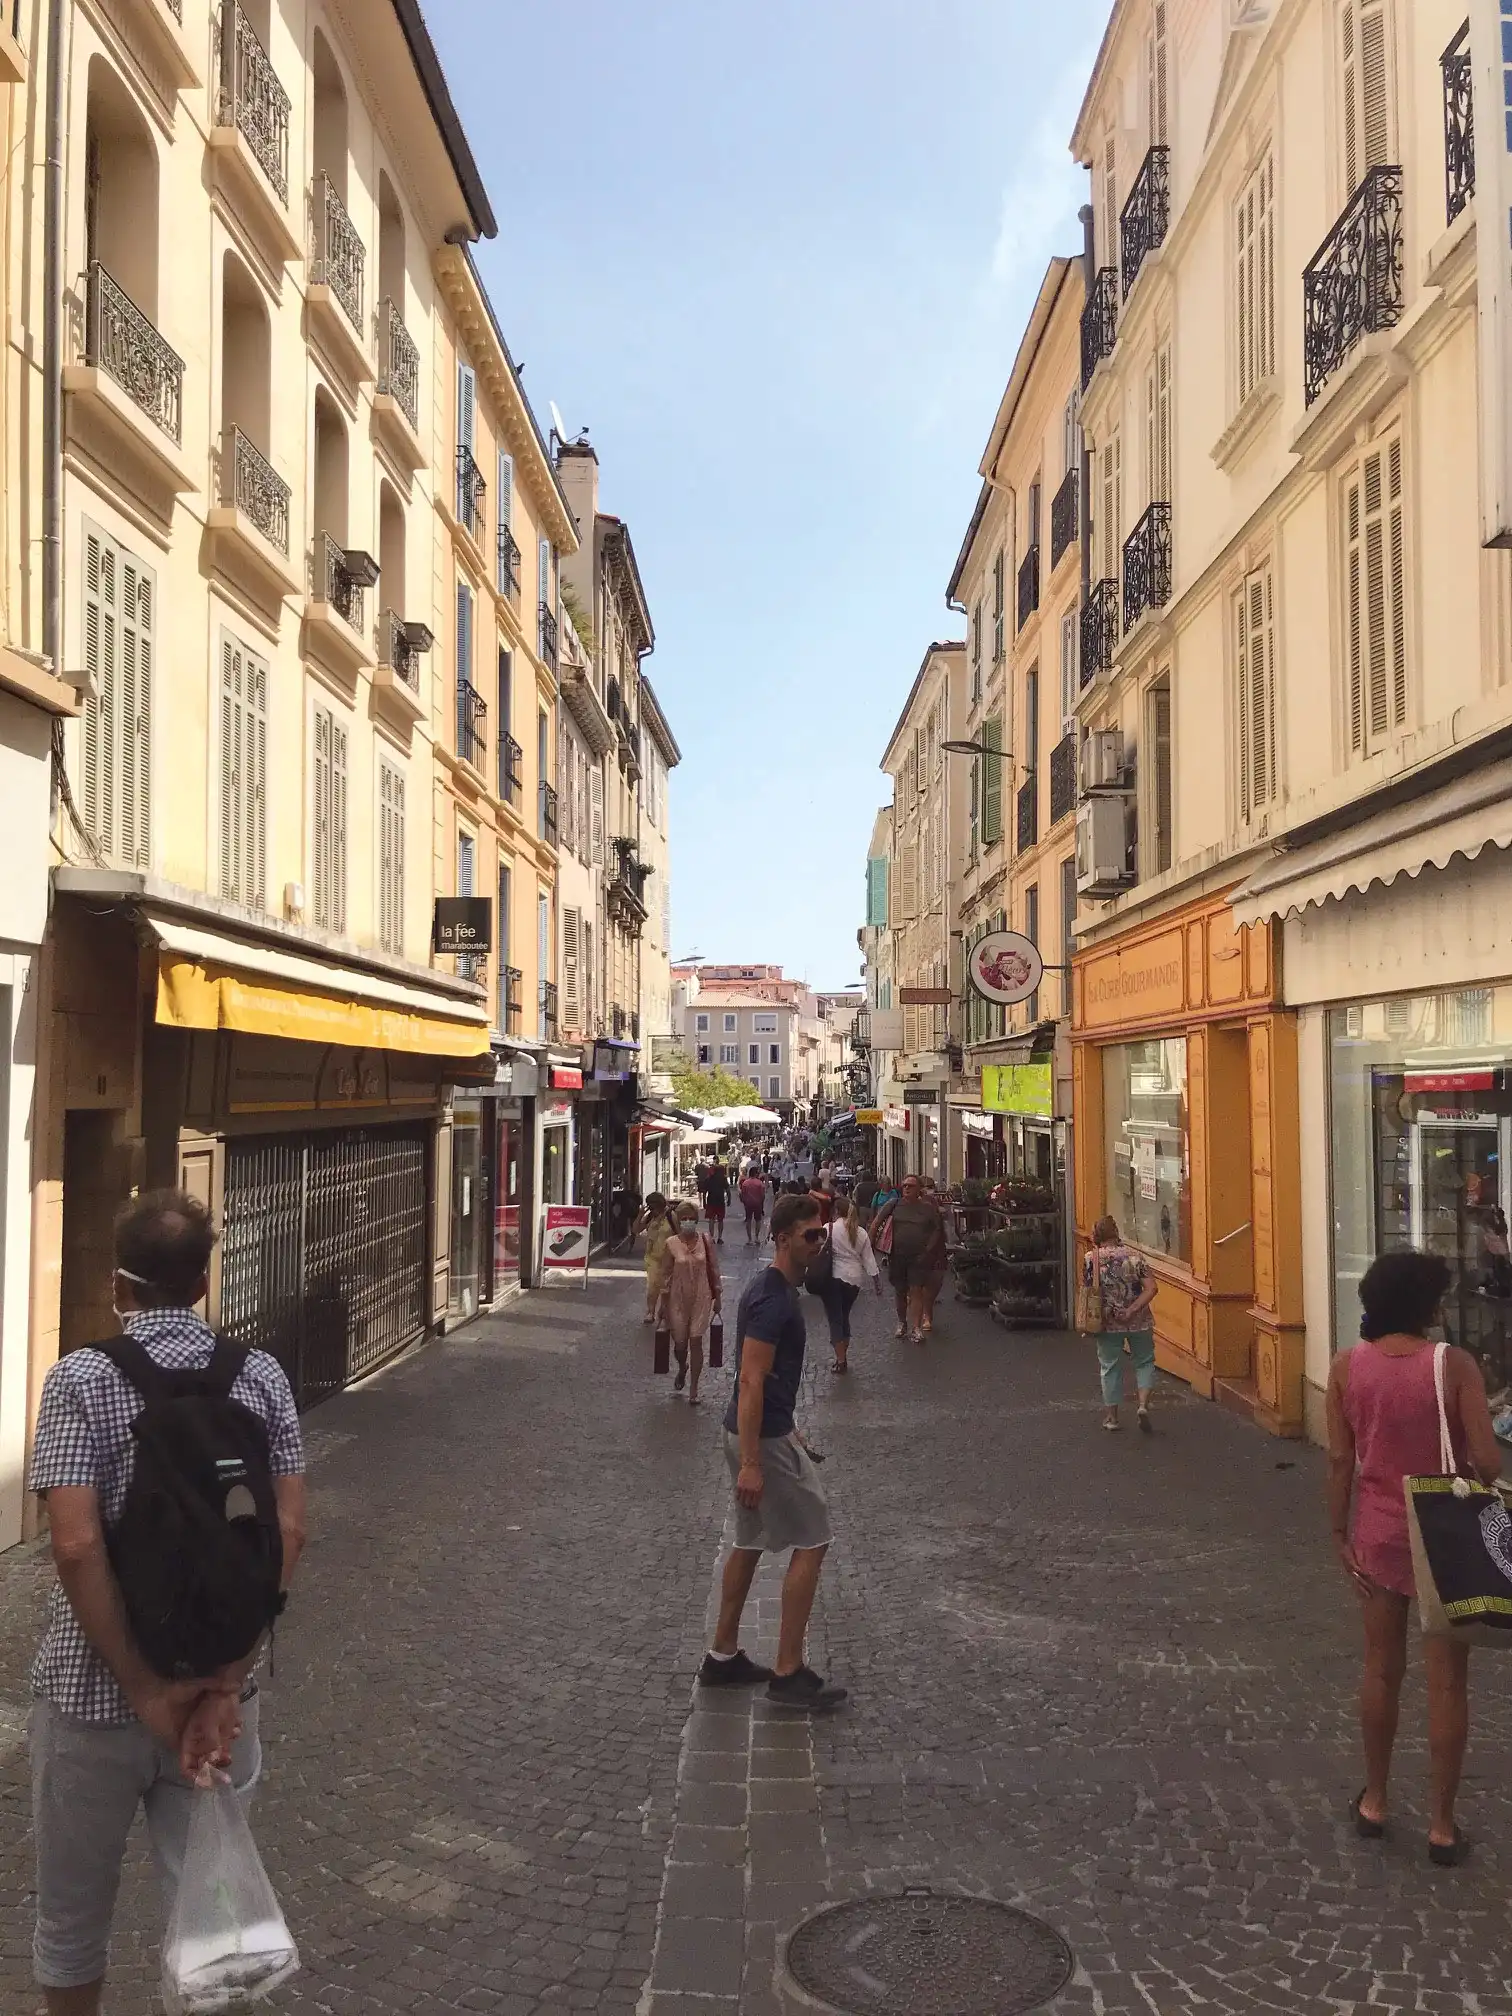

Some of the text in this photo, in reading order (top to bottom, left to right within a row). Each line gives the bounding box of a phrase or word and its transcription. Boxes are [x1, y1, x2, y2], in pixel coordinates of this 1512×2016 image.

[441, 923, 476, 942] la fée
[441, 942, 488, 950] maraboutée
